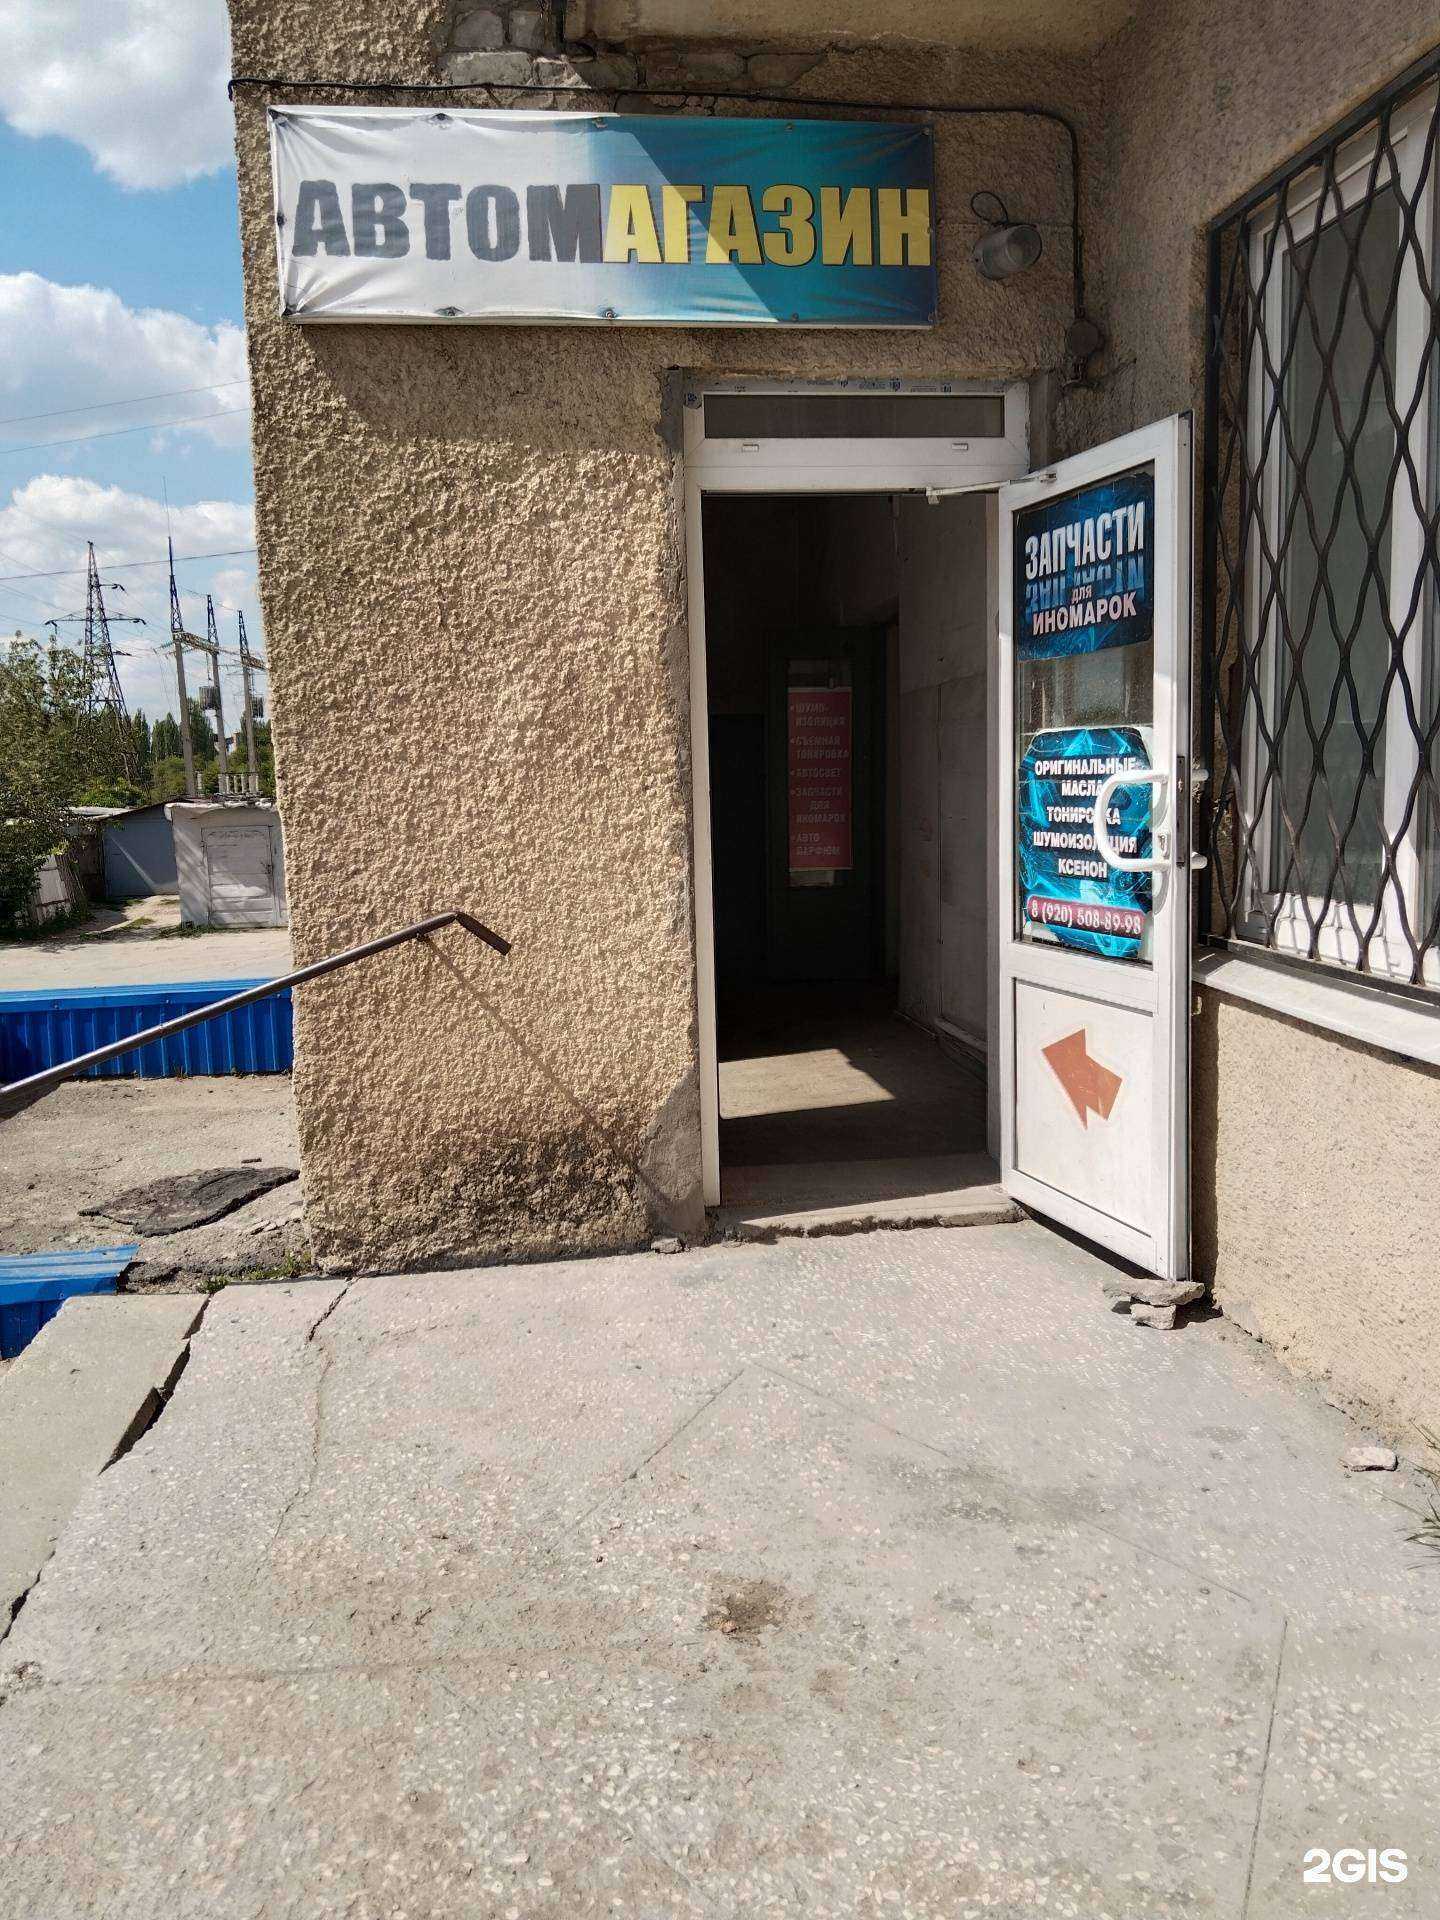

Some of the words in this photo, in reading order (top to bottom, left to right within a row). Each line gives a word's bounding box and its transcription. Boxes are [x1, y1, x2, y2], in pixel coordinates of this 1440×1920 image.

[292, 180, 931, 266] АВТОМАГАЗИН
[1025, 501, 1146, 580] ЗАПЧАСТИ
[1071, 585, 1092, 603] ДЛЯ
[1033, 591, 1137, 636] ИНОМАРОК
[1047, 806, 1121, 825] ТОНИРОКА
[1033, 832, 1137, 854] ШУМОИЗОЛЦИЯ
[1058, 860, 1107, 878] КСЕНОН
[1031, 900, 1039, 917] 8
[1042, 902, 1072, 927] (920)
[1077, 907, 1141, 934] 508-89-98
